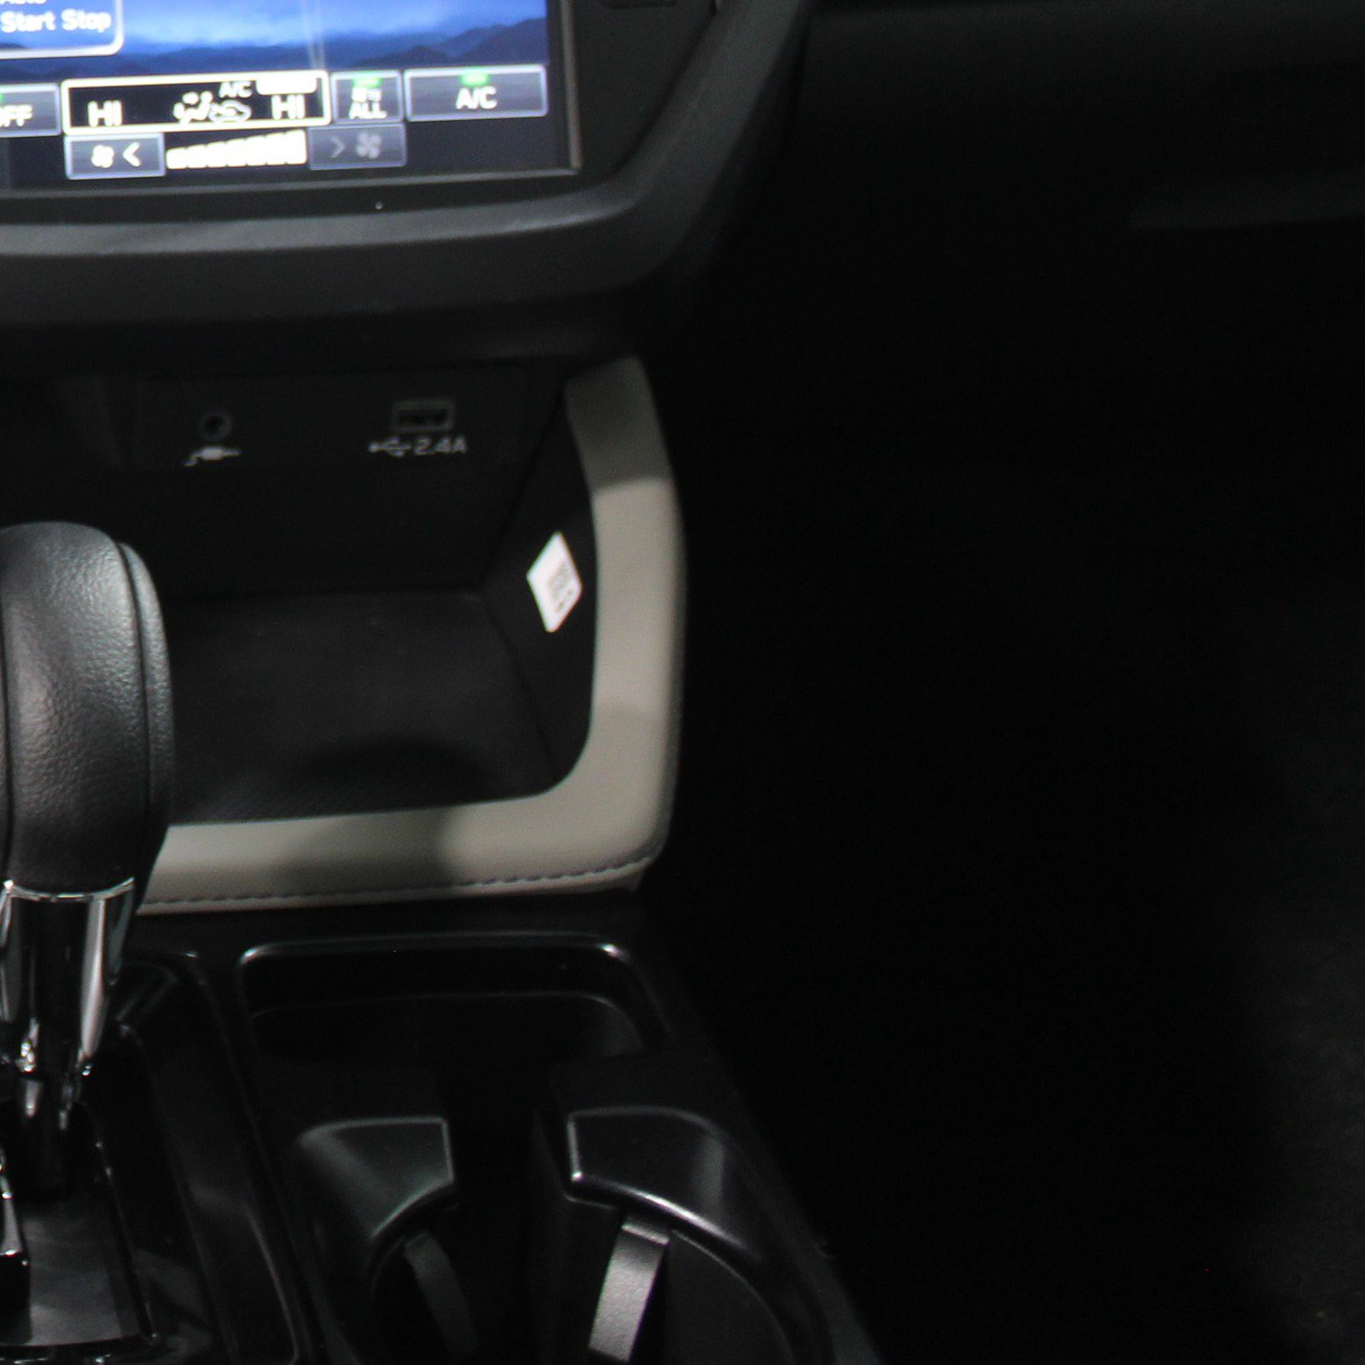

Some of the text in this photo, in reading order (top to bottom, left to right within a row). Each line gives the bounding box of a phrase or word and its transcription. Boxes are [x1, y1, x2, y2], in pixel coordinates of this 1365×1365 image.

[0, 8, 112, 34] Start Stop
[271, 94, 305, 120] HI
[456, 87, 497, 110] A/C
[87, 101, 122, 127] HI
[349, 101, 386, 122] ALL
[414, 437, 466, 454] 2.4A
